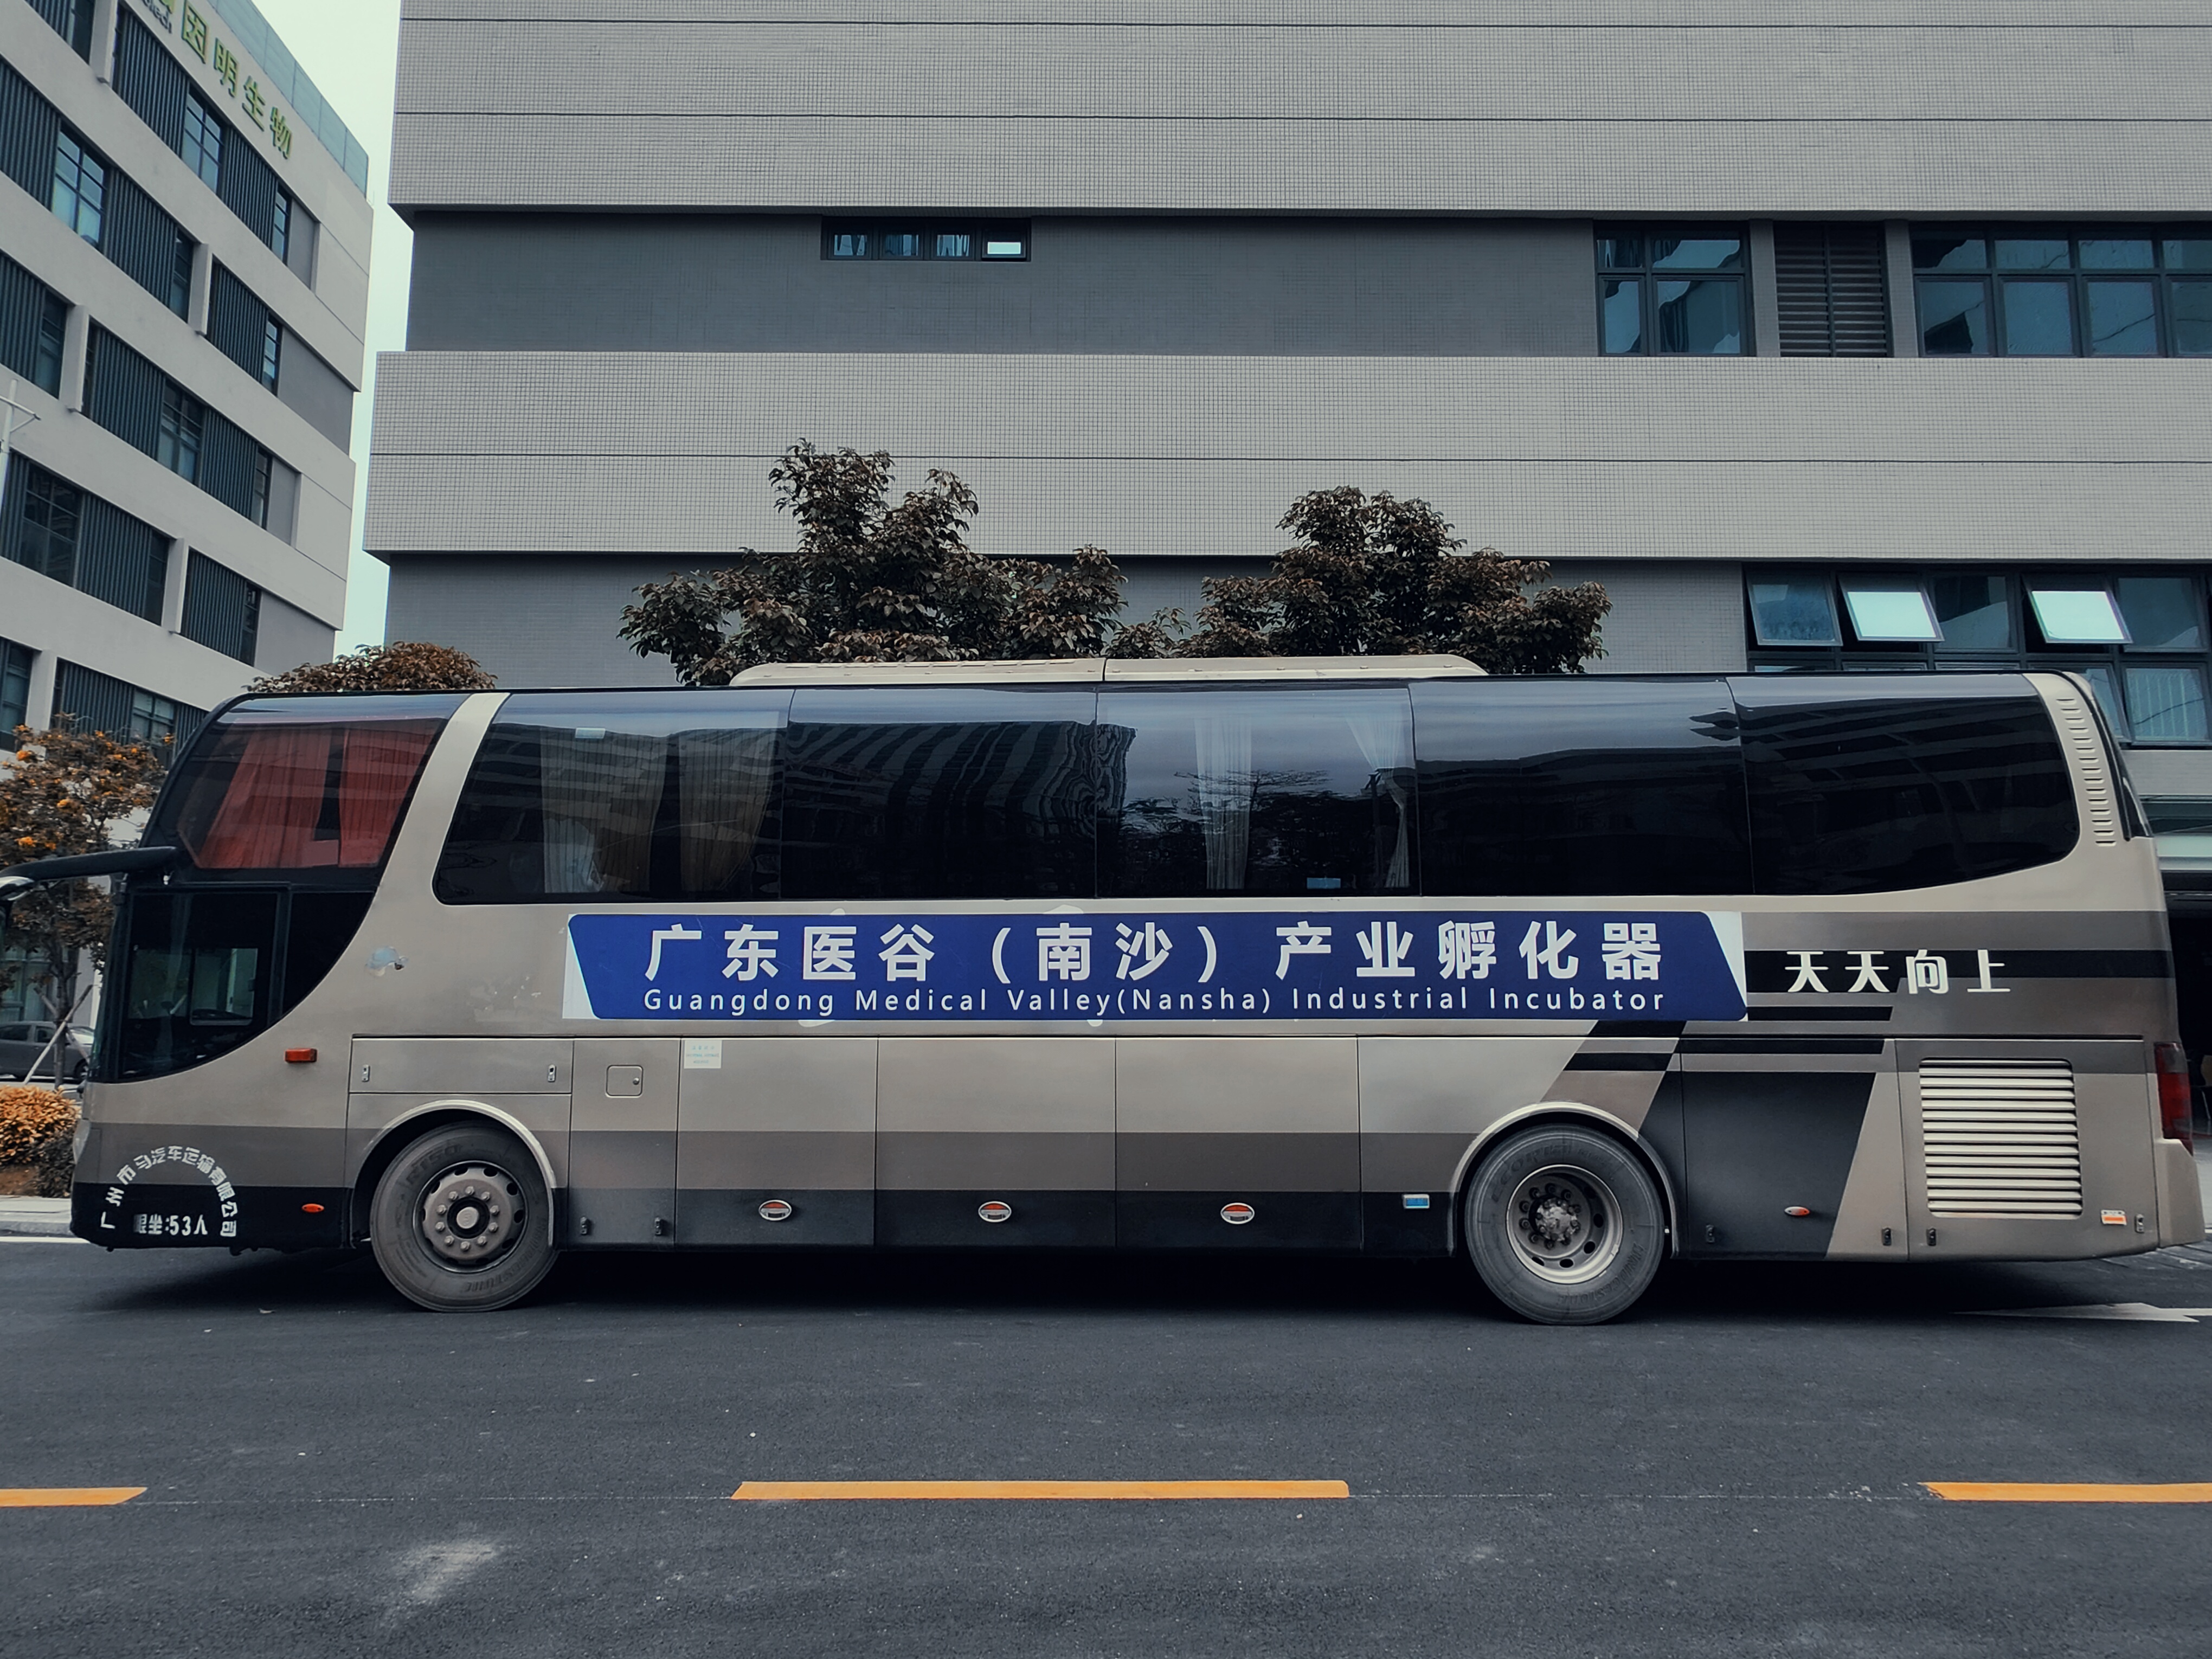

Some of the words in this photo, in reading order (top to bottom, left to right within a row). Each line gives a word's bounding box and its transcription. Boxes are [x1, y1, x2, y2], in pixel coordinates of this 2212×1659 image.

[1784, 949, 2011, 994] 天天向上
[644, 988, 834, 1017] Guangdong
[856, 988, 986, 1011] Medical
[1007, 987, 1270, 1017] Valley(Nansha)
[1293, 987, 1467, 1010] Industrial
[1489, 987, 1664, 1011] Incubator
